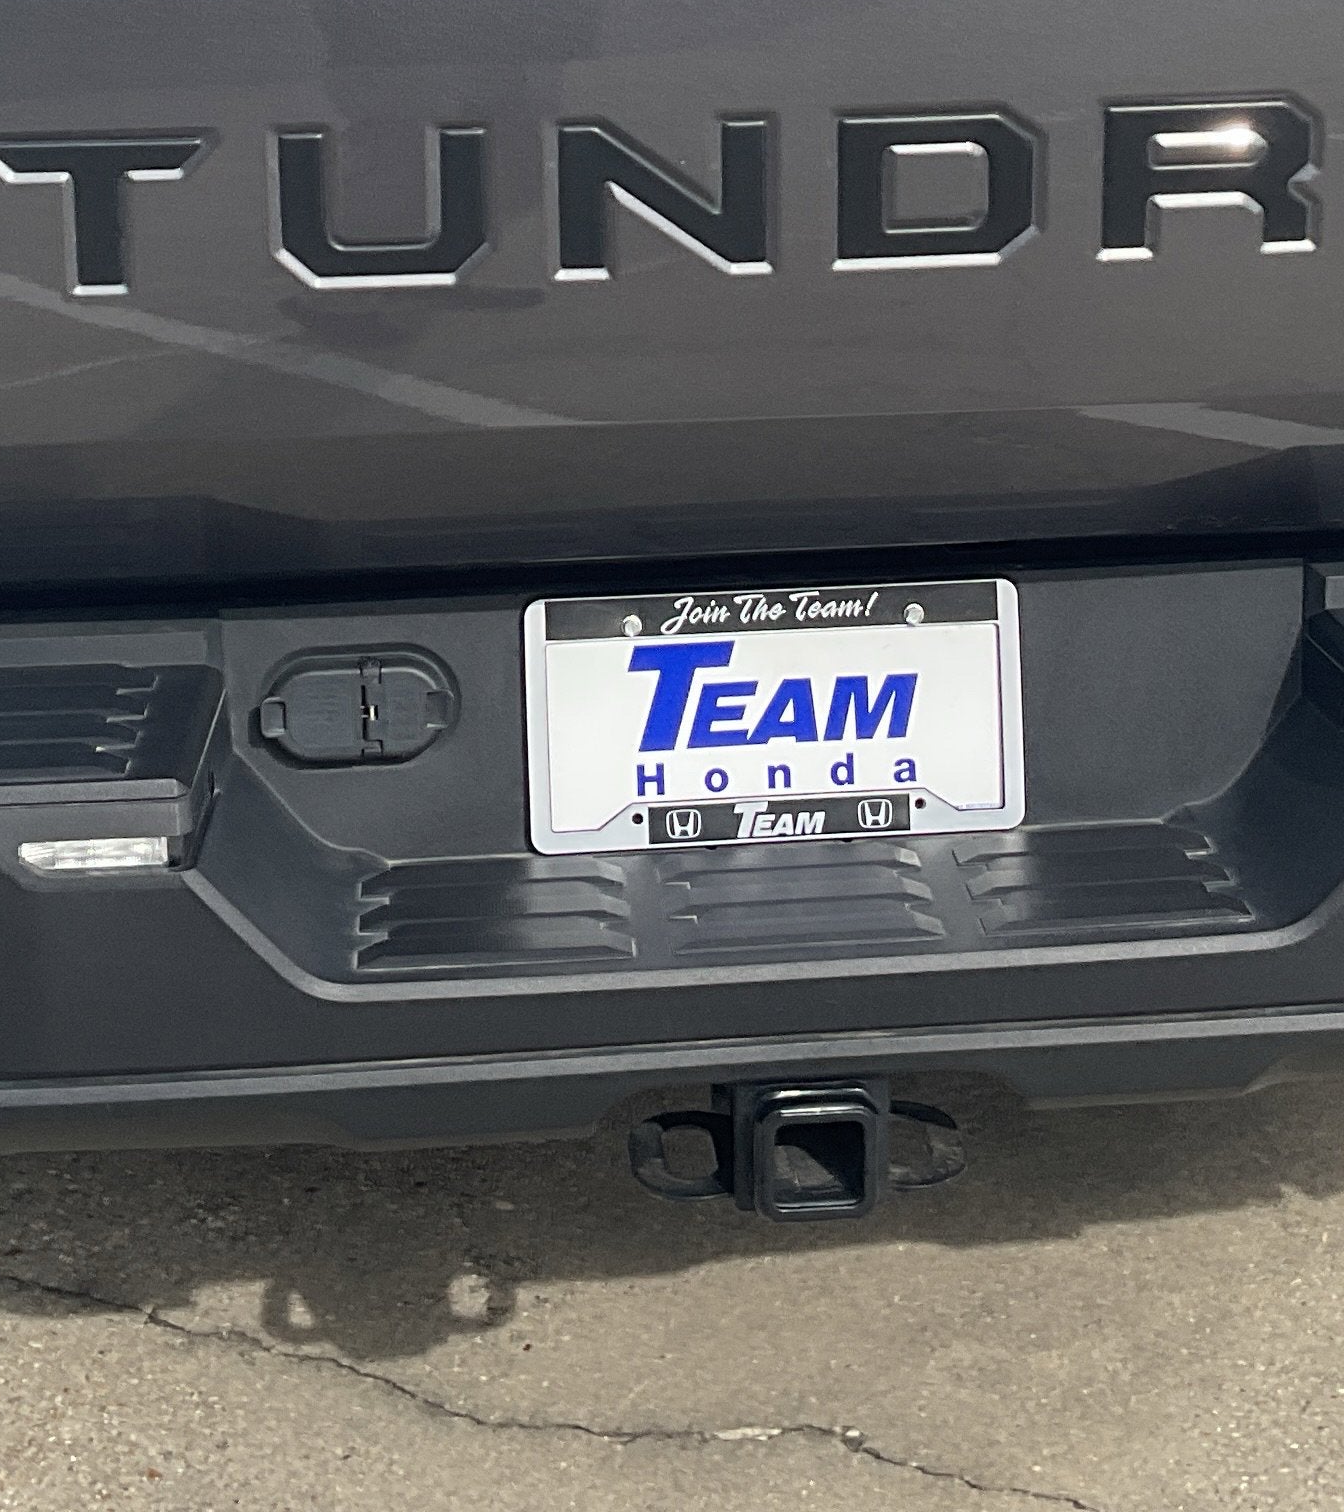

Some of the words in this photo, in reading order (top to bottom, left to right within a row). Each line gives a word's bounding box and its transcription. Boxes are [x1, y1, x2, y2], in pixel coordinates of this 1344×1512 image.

[660, 596, 730, 635] Join
[733, 593, 786, 624] The
[789, 590, 879, 621] Team!
[627, 640, 918, 752] TEAM
[635, 753, 918, 797] Honda
[732, 801, 826, 839] TEAM
